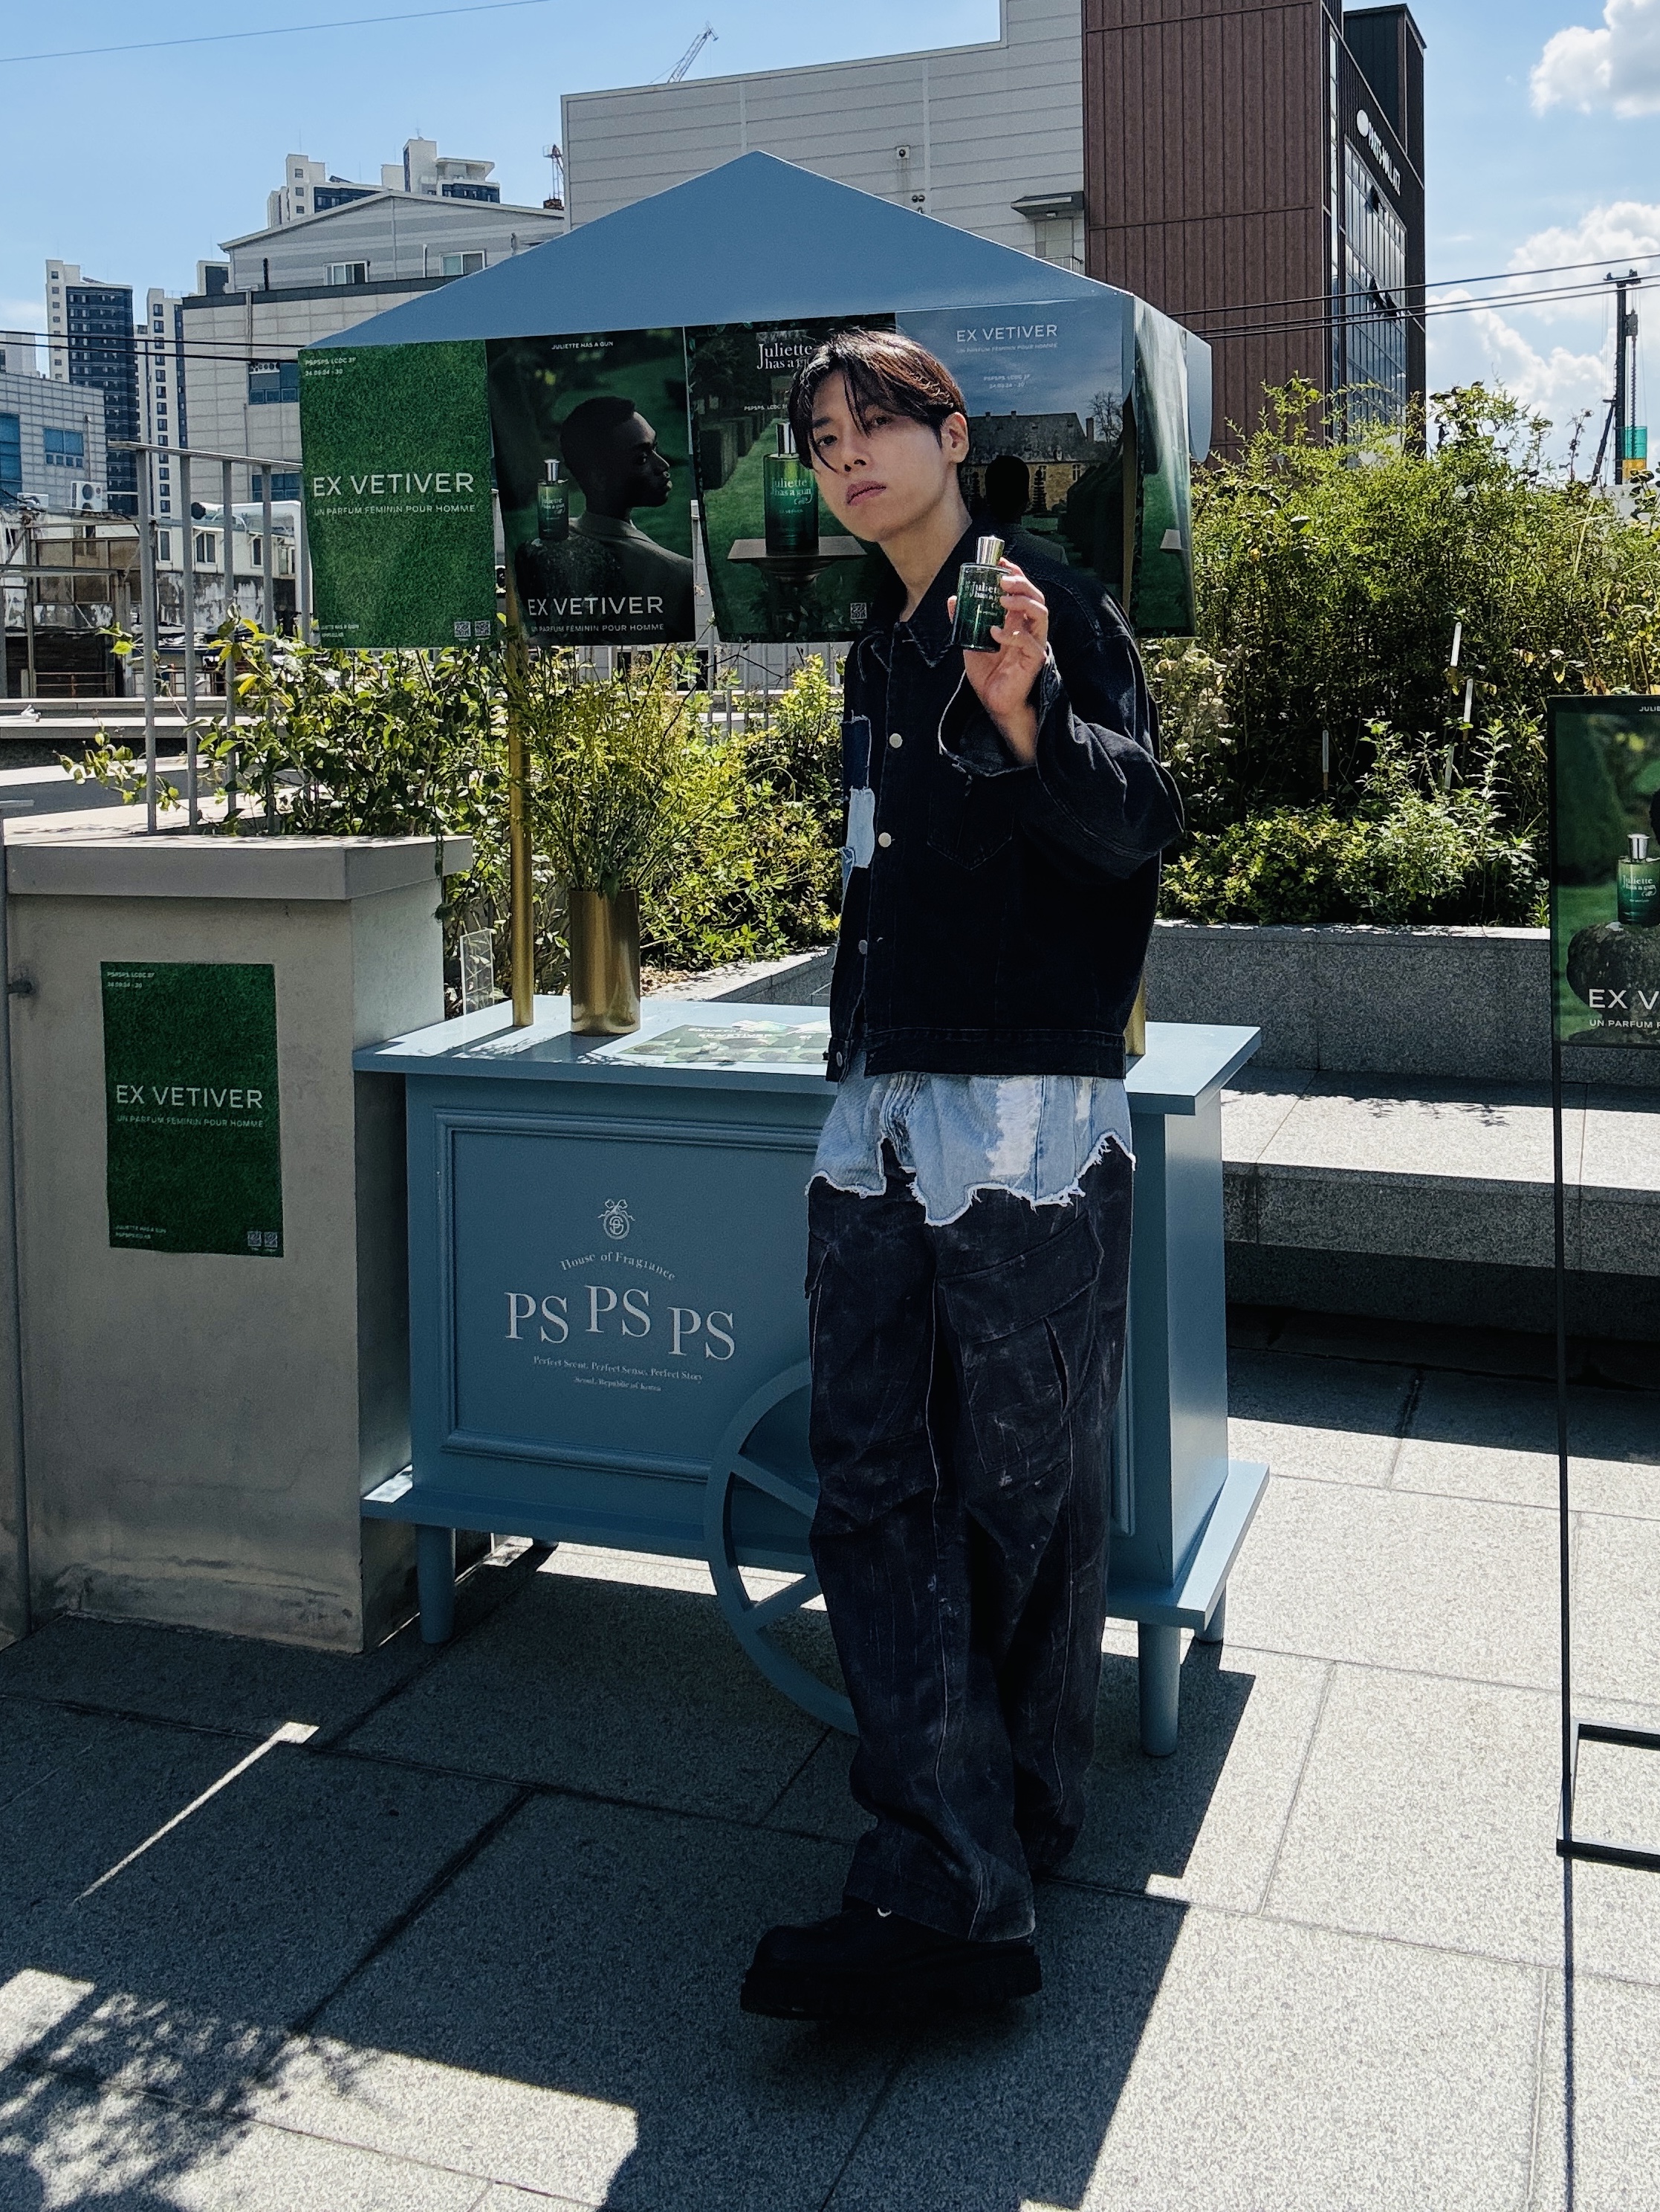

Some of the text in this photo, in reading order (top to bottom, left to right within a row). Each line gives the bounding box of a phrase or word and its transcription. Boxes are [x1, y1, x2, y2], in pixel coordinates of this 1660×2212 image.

[956, 324, 1057, 343] EX VETIVER
[756, 343, 813, 369] Juliette
[765, 358, 785, 369] has
[788, 360, 794, 368] a
[313, 473, 474, 497] EX VETIVER
[327, 507, 363, 515] PARFUM
[435, 505, 476, 513] HOMME
[528, 596, 664, 616] EX VETIVER
[1589, 988, 1628, 1009] EX
[1589, 1019, 1604, 1027] UN
[1608, 1019, 1653, 1028] PARFUM
[116, 1084, 263, 1109] EX VETIVER
[204, 1119, 227, 1127] POUR
[230, 1120, 264, 1128] HOMME
[560, 1251, 675, 1281] House of Fragrance
[504, 1284, 736, 1361] PS PS PS
[534, 1355, 562, 1366] Perfect
[591, 1361, 620, 1372] Perfect
[650, 1368, 679, 1378] Perfect
